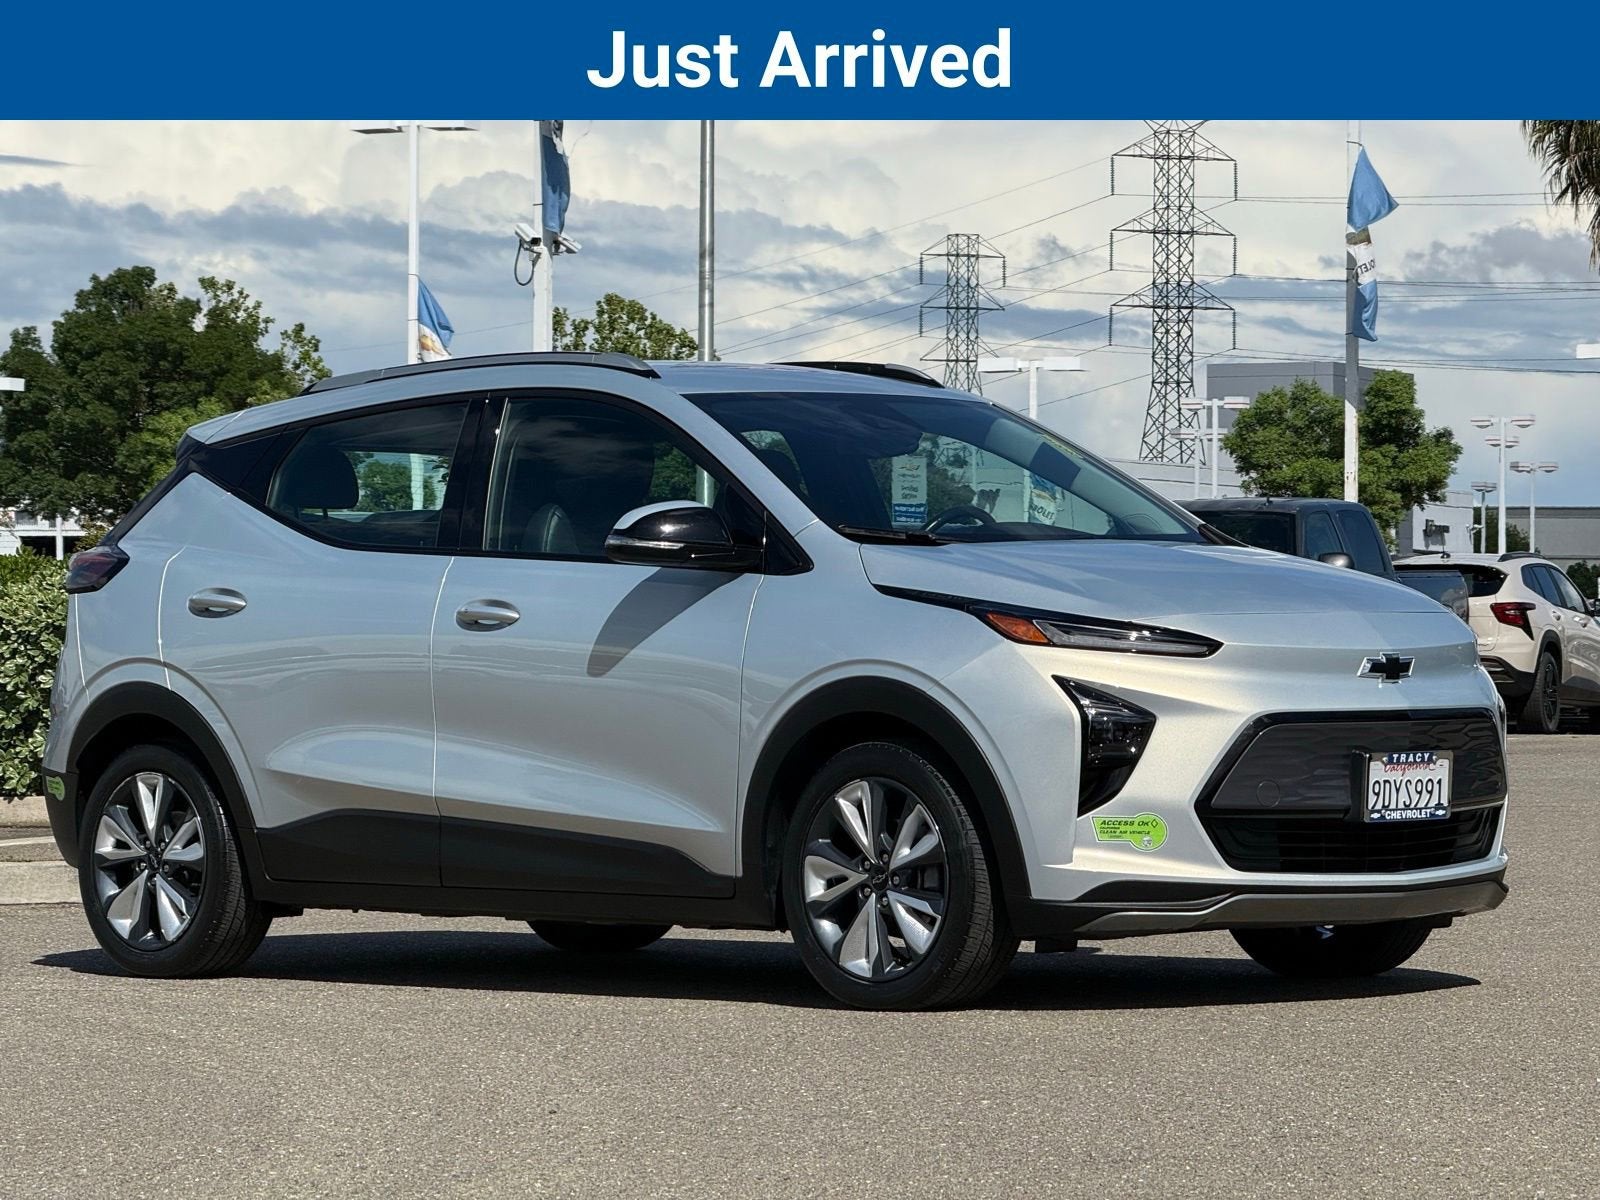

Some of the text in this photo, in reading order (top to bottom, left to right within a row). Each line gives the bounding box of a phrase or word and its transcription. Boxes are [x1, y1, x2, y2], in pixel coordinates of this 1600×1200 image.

[1392, 753, 1430, 763] TRACY
[1371, 778, 1444, 809] 9DYS991
[1385, 809, 1431, 819] CHEVROLET
